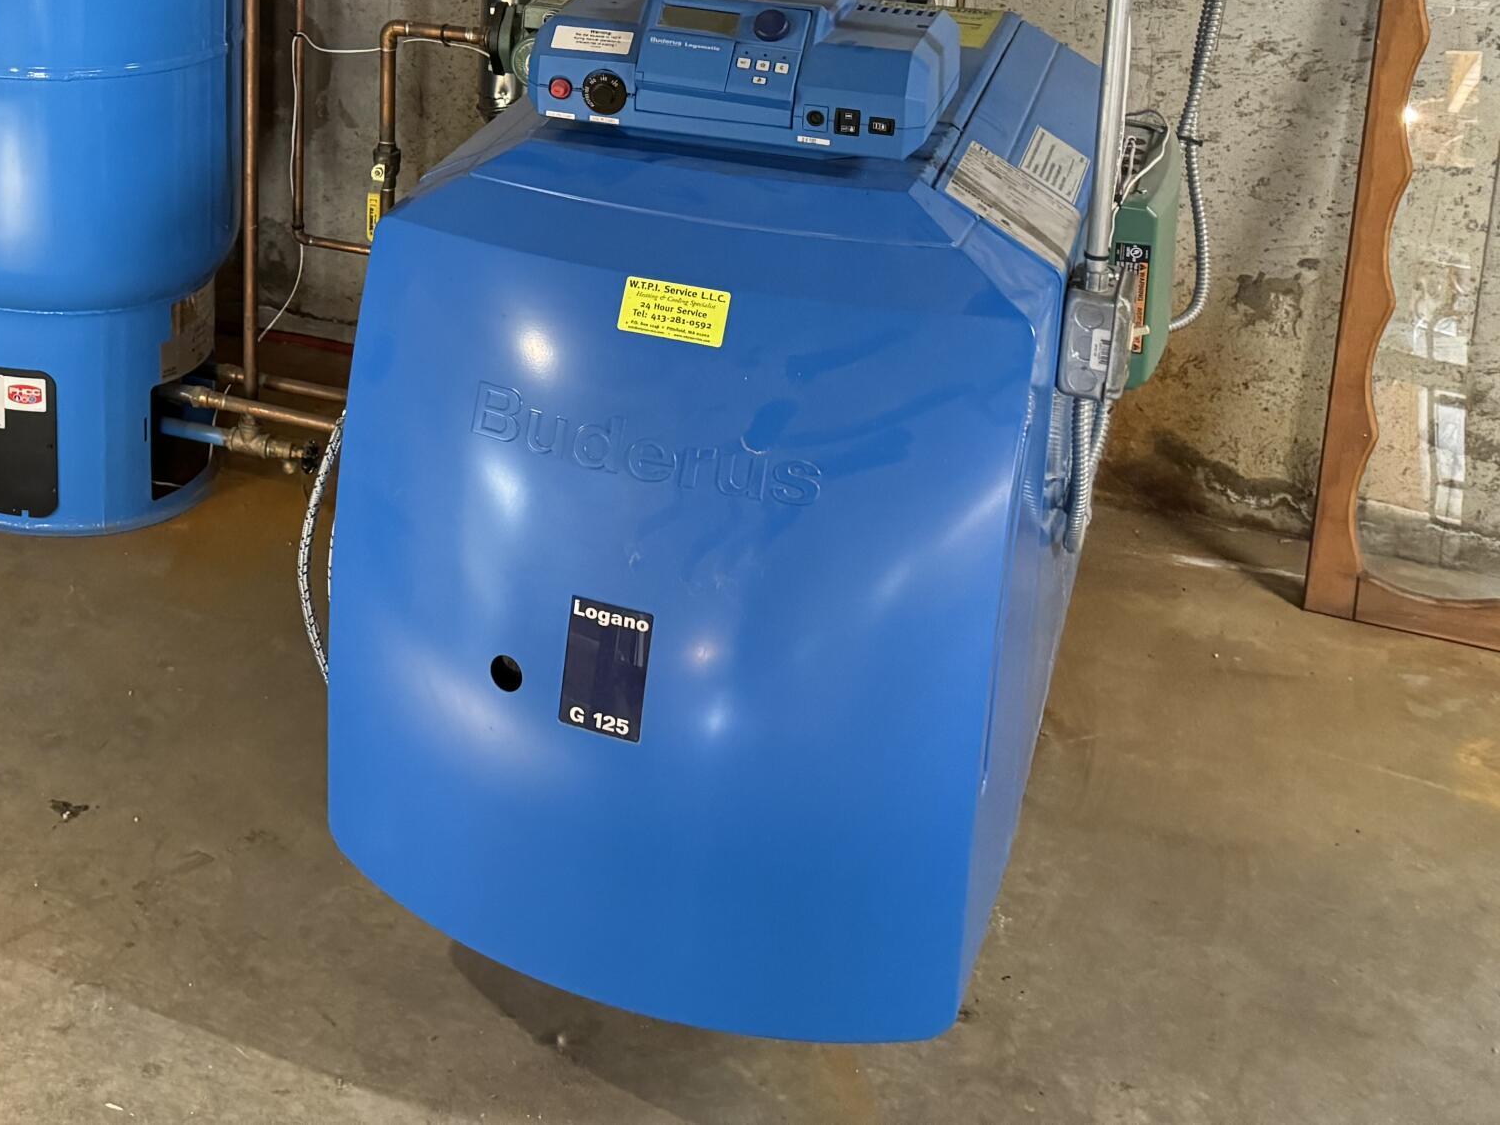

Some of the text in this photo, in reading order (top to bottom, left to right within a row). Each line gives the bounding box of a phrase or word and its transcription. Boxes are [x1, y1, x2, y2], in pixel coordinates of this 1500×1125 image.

[629, 280, 726, 303] W.T.P.I. Service L.L.C.
[633, 309, 712, 329] Tel: 413-281-0592
[640, 302, 708, 319] 24 Hour Service
[471, 380, 822, 506] Buderus
[573, 599, 649, 633] Logano
[569, 706, 630, 736] G 125
